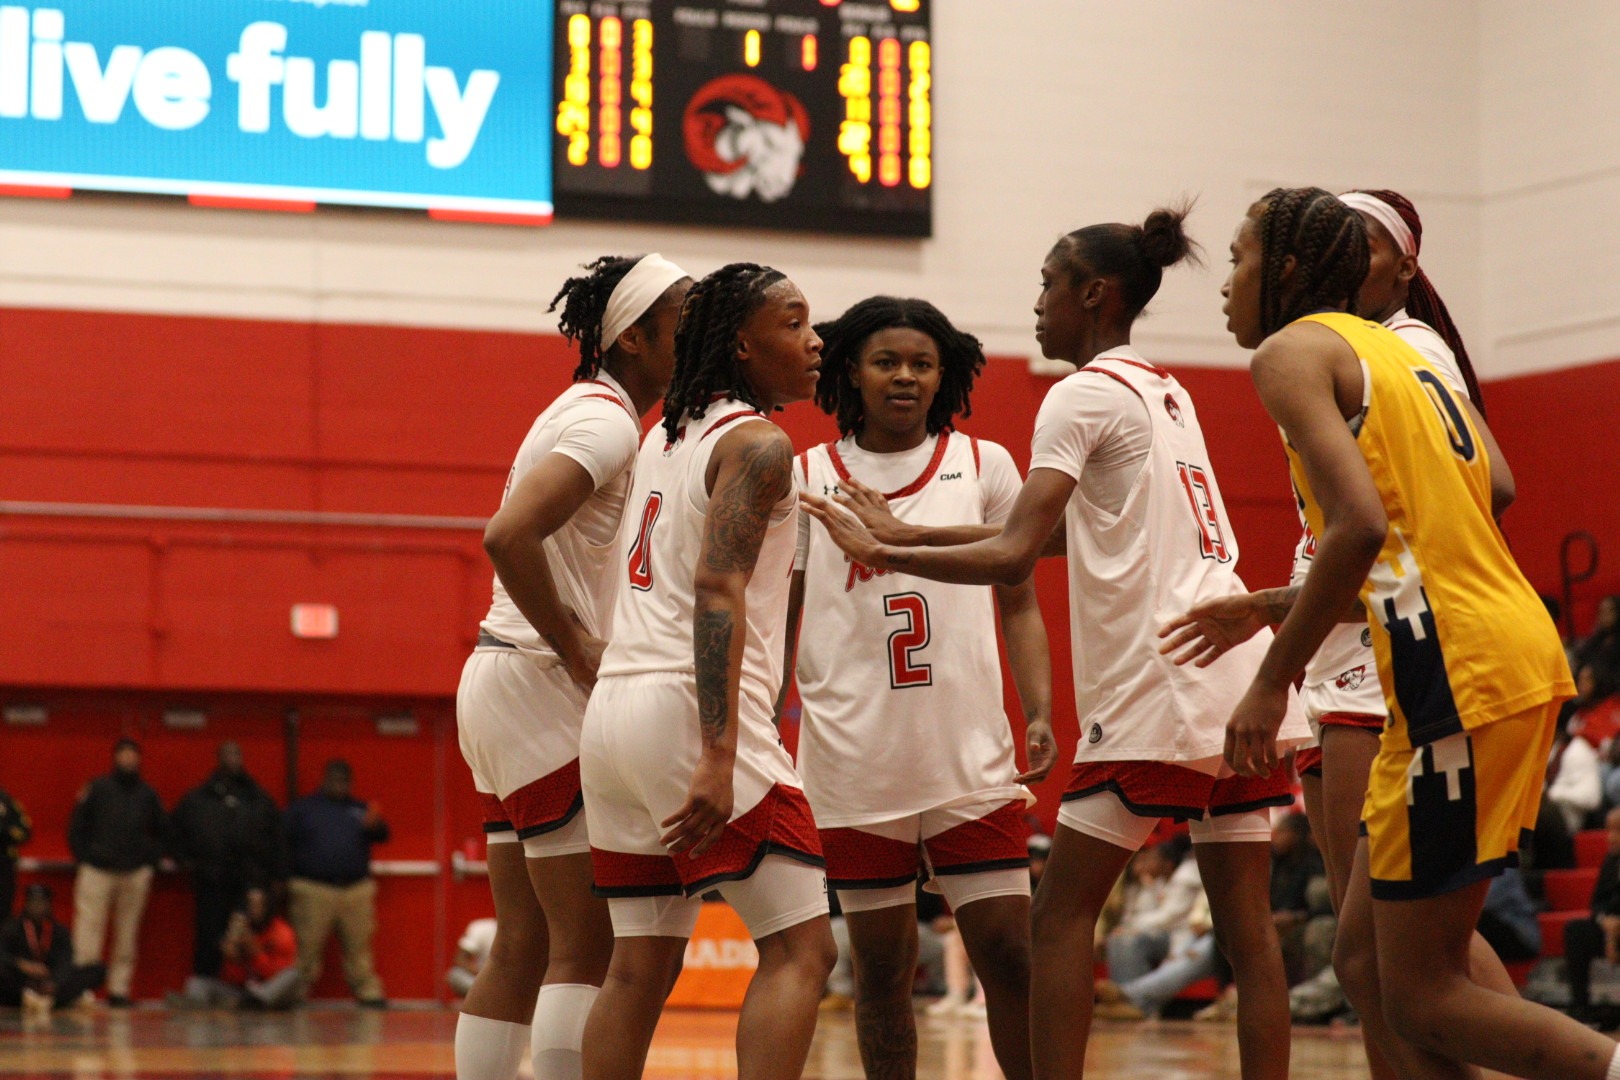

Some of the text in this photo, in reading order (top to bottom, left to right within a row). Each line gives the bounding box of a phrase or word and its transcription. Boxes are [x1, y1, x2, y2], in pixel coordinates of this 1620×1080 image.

[0, 5, 211, 130] live
[226, 20, 500, 169] fully
[1411, 365, 1477, 466] 0
[940, 471, 963, 481] CIAA
[1175, 460, 1233, 564] 13
[627, 490, 663, 592] 0
[883, 591, 933, 689] 2
